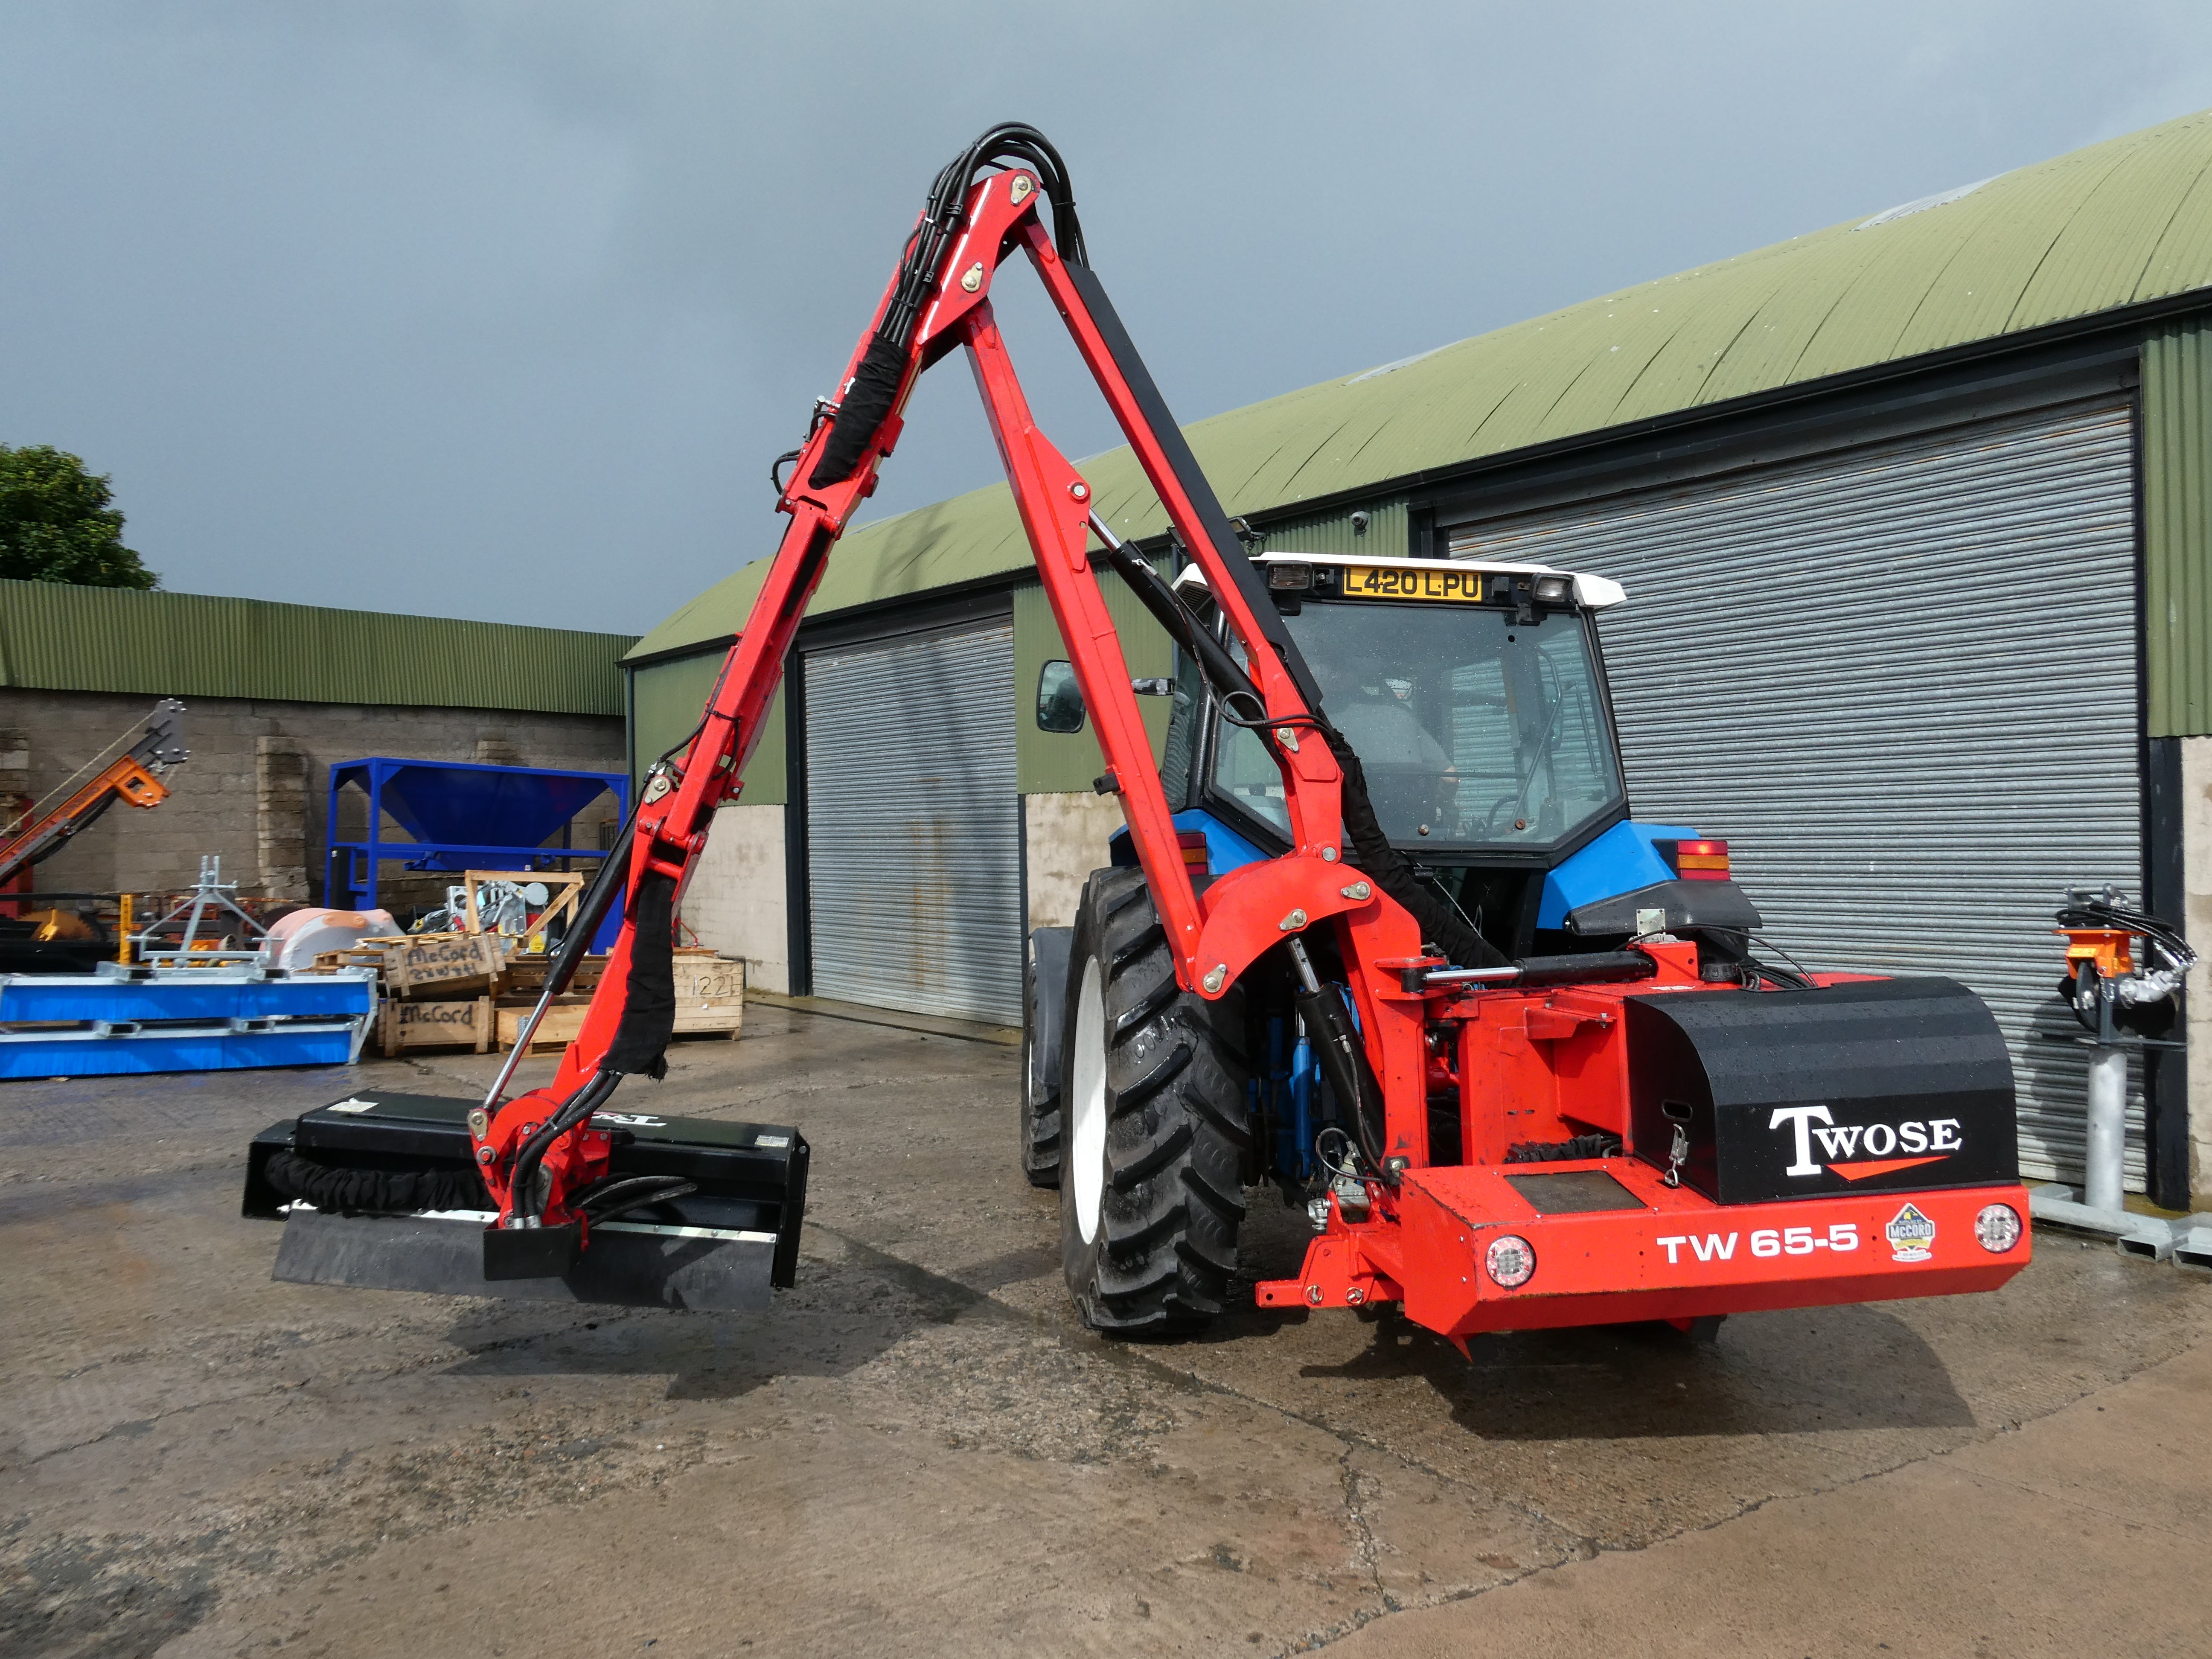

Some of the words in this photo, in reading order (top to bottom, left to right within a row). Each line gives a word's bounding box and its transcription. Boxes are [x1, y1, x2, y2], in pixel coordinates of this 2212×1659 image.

[1346, 568, 1417, 594] L420
[1425, 572, 1479, 598] LPU
[407, 941, 483, 966] McCord
[399, 1004, 475, 1030] McCord
[1656, 1232, 1738, 1263] TW
[1750, 1223, 1859, 1257] 65-5
